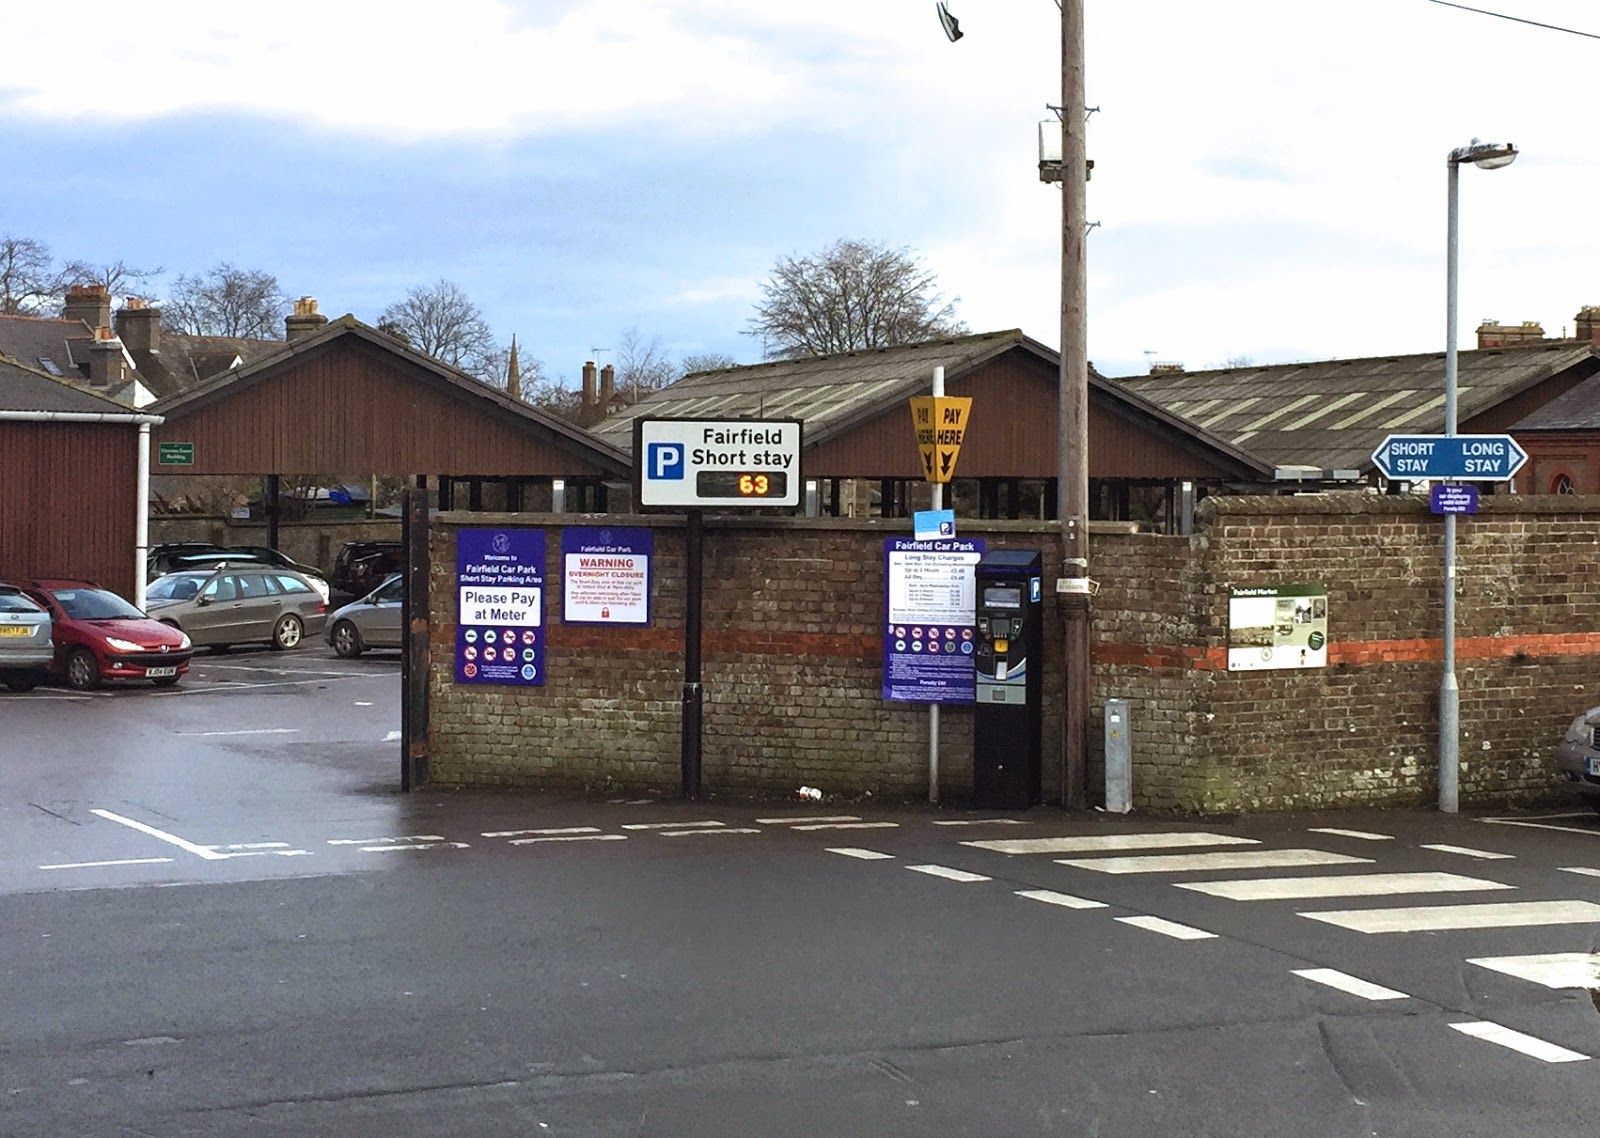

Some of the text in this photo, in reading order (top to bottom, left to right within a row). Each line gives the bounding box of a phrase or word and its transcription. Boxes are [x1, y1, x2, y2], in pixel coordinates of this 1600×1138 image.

[943, 408, 961, 424] PAY
[703, 428, 782, 444] Fairfield
[938, 430, 961, 445] HERE
[1391, 443, 1435, 455] SHORT
[1462, 443, 1504, 455] LONG
[657, 447, 679, 476] P
[691, 449, 793, 468] Short stay
[1397, 459, 1428, 472] STAY
[1464, 459, 1501, 472] STAY
[739, 475, 768, 494] 63
[895, 541, 974, 551] Fairfield Car Park
[466, 564, 536, 574] Fairfield Car Park
[579, 558, 634, 568] WARNING
[460, 574, 479, 582] Short
[480, 575, 496, 584] Stay
[497, 575, 524, 584] Parking
[1033, 581, 1040, 598] P
[465, 591, 535, 607] Please Pay
[475, 608, 526, 620] at Meter
